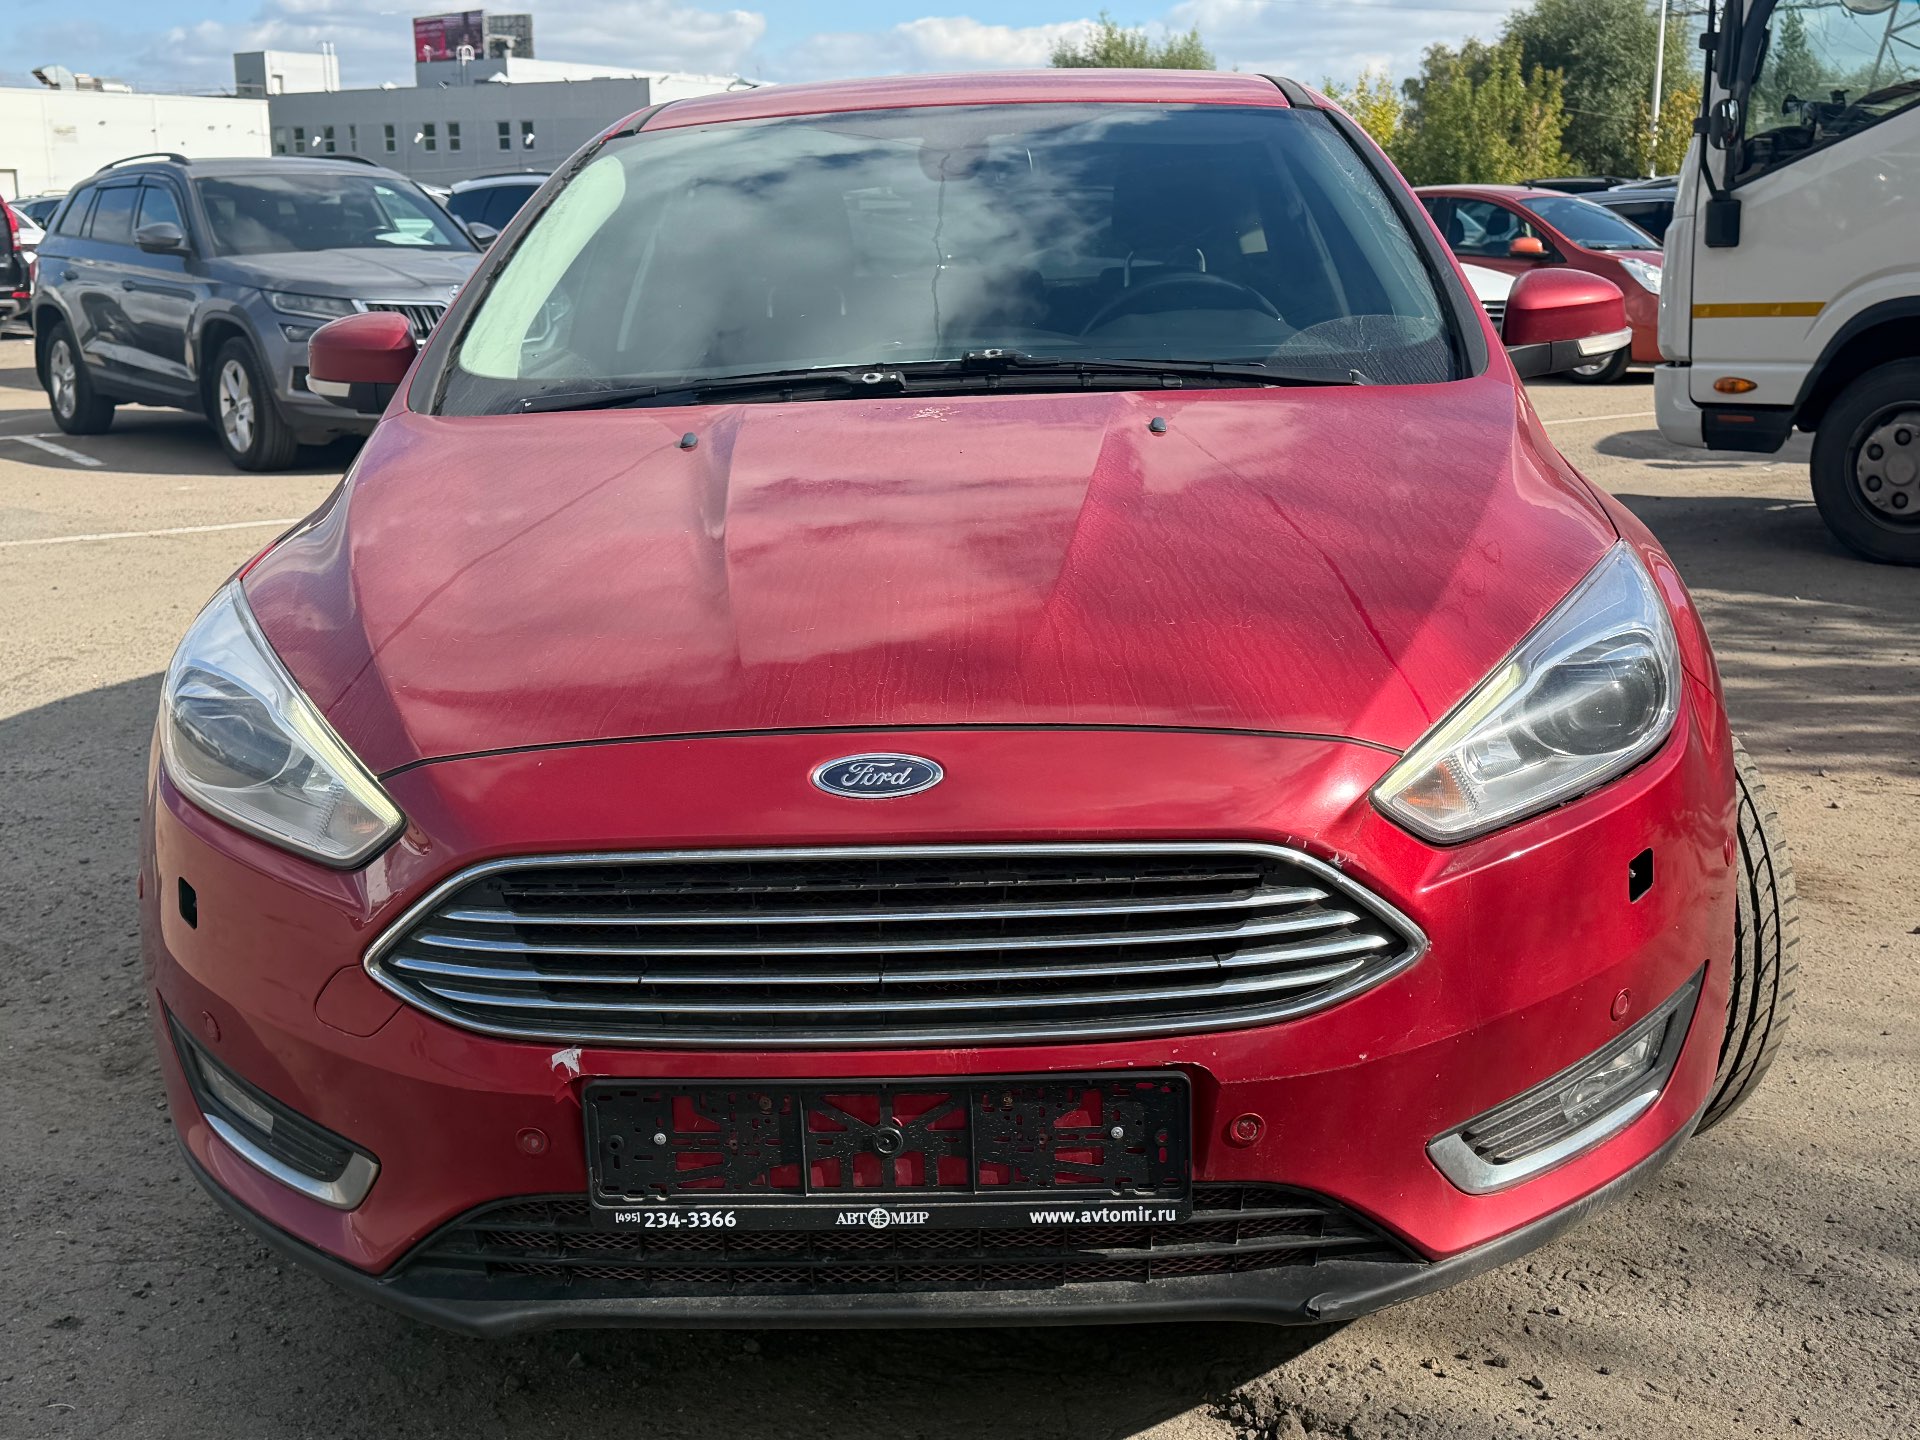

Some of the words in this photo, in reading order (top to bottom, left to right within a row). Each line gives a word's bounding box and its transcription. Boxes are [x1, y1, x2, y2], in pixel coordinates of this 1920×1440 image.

[840, 762, 913, 787] Ford
[643, 1210, 737, 1229] 234-3366
[1029, 1205, 1176, 1224] www.avtomir.ru
